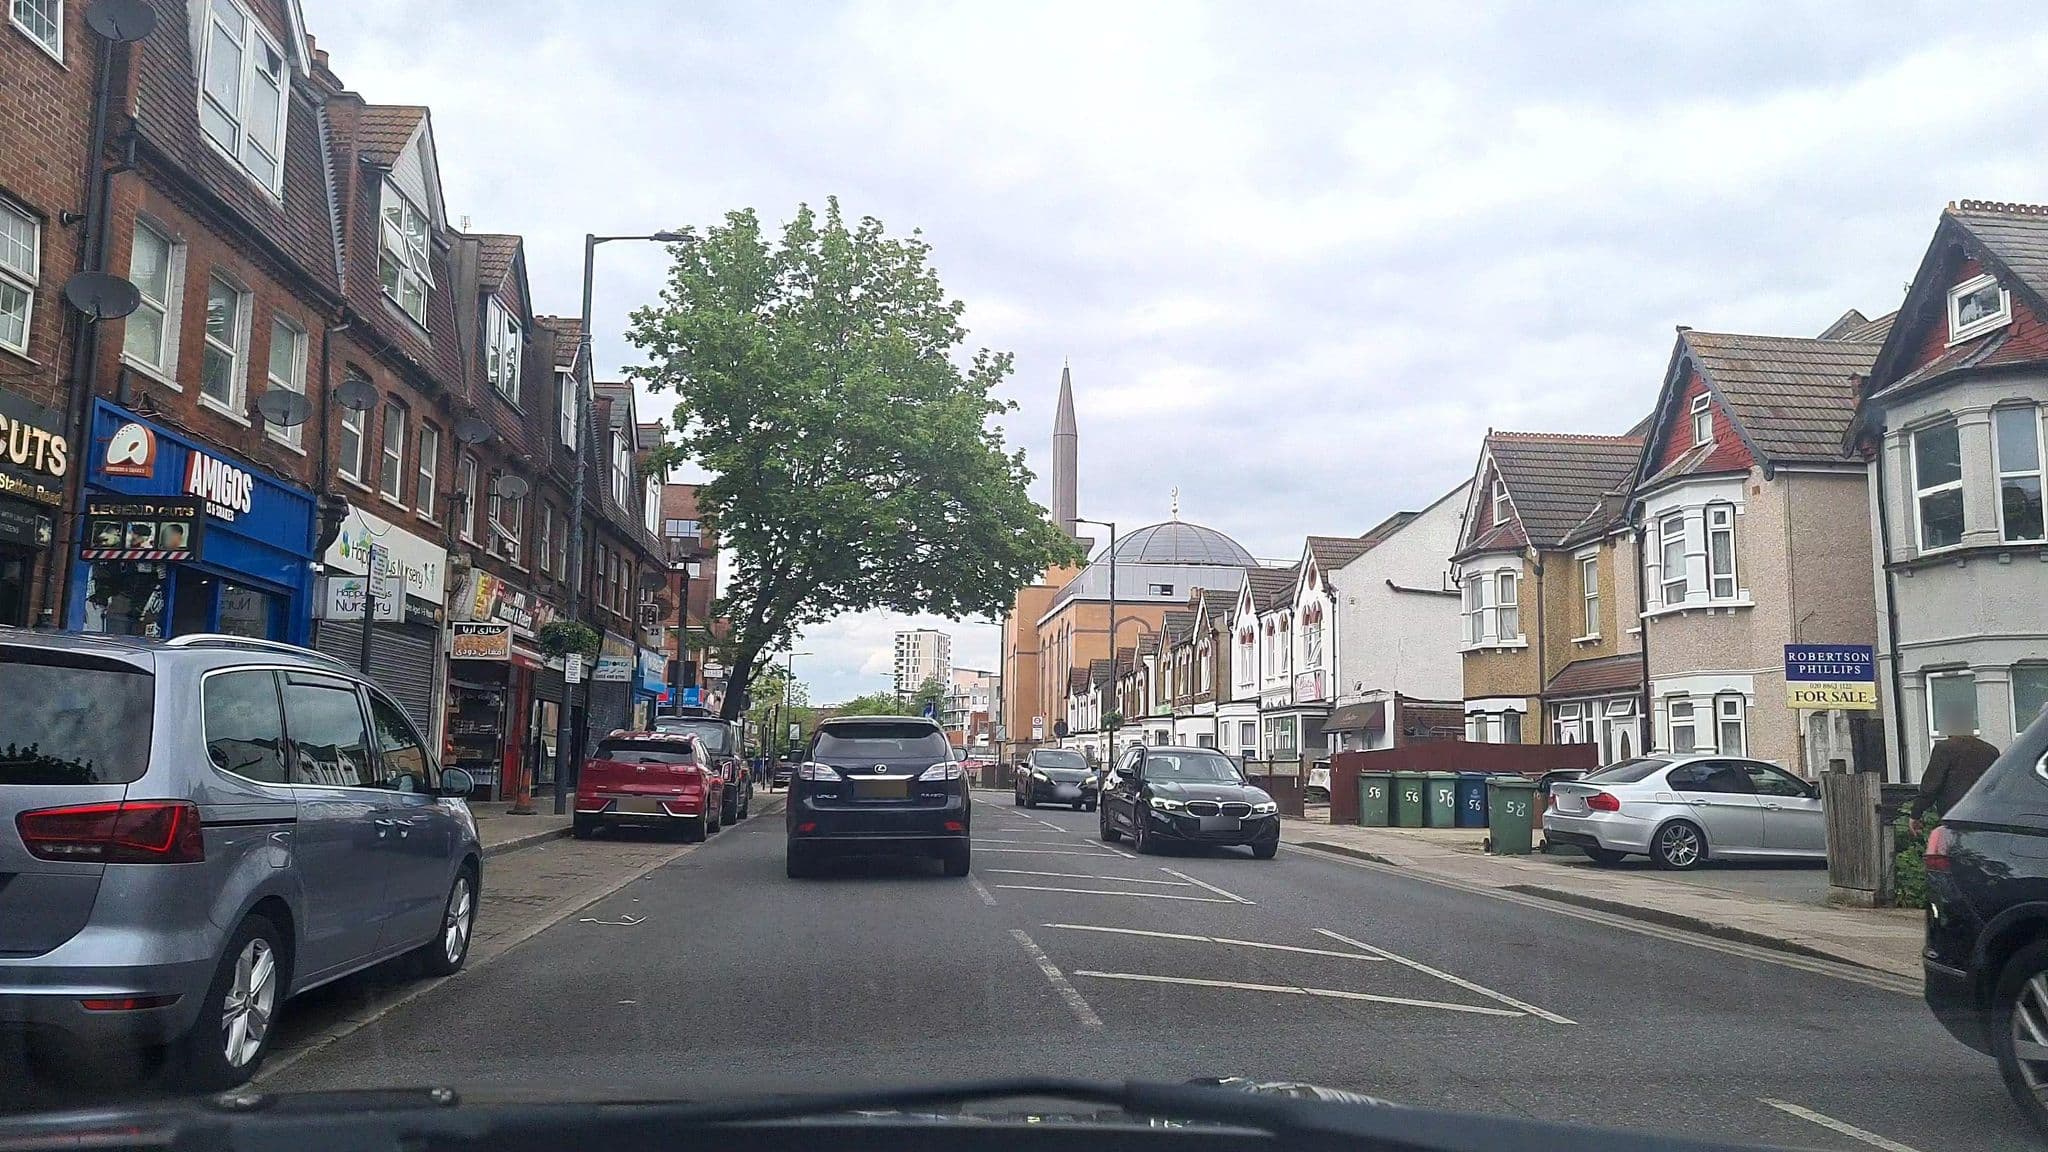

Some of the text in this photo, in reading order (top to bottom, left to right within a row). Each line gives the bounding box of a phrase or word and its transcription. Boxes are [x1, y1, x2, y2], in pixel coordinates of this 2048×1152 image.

[189, 451, 253, 514] AMIGOS
[36, 484, 63, 506] Road
[89, 503, 154, 516] LEGEND
[158, 506, 195, 517] CUTS
[1788, 652, 1870, 662] ROBERTSON
[1799, 664, 1861, 674] PHILLIPS
[1794, 690, 1868, 704] FOR SALE
[1368, 786, 1381, 799] 56
[1405, 791, 1419, 803] 56
[1438, 789, 1455, 808] 56
[1468, 799, 1481, 811] 56
[1506, 801, 1526, 817] 58
